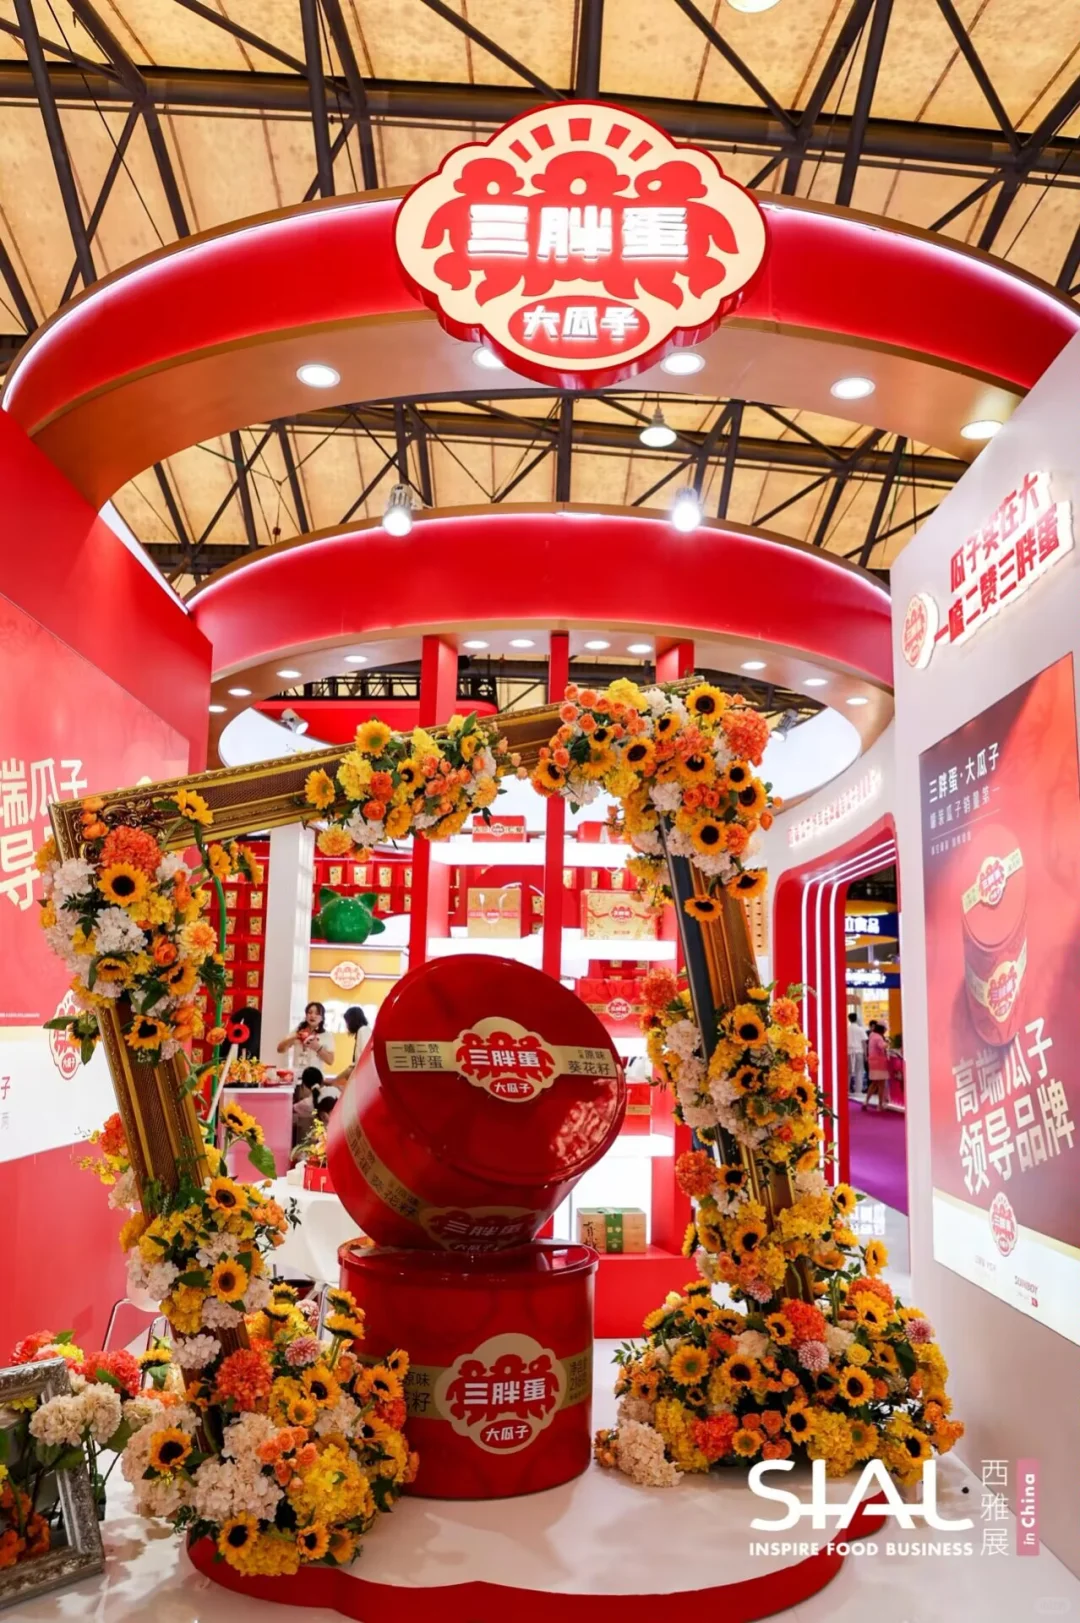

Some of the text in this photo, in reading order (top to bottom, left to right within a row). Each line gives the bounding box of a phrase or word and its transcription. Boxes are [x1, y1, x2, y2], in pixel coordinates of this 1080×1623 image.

[467, 204, 690, 260] 三胖蛋
[522, 304, 640, 341] 大瓜子
[393, 1054, 444, 1069] 三胖蛋
[469, 1048, 541, 1068] 三胖蛋
[567, 1059, 611, 1076] 葵花籽
[951, 1016, 1054, 1122] 高端瓜子
[493, 1082, 532, 1094] 大瓜子
[958, 1078, 1076, 1196] 领导品牌
[464, 1377, 546, 1405] 三胖蛋
[486, 1425, 529, 1442] 大瓜子
